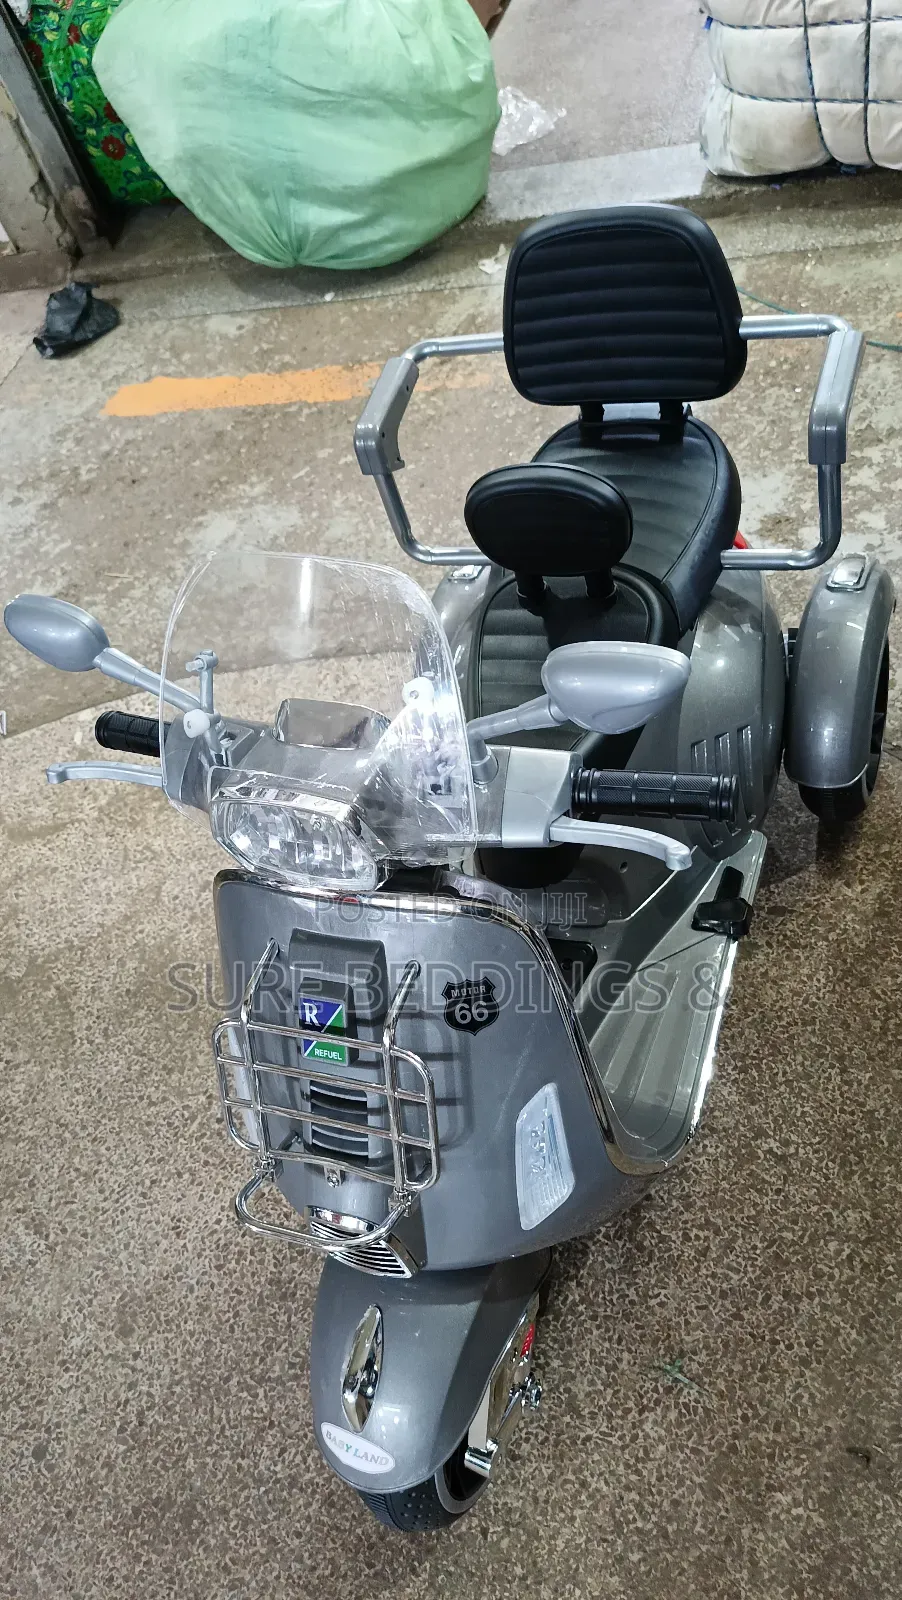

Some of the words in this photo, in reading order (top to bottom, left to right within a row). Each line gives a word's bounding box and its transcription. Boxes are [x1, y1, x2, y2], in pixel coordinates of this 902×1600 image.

[451, 985, 486, 997] MOTOR
[302, 1001, 321, 1027] R
[454, 1000, 489, 1024] 66
[314, 1048, 343, 1061] REFUEL
[326, 1431, 352, 1453] BABY
[353, 1448, 389, 1466] LAND
